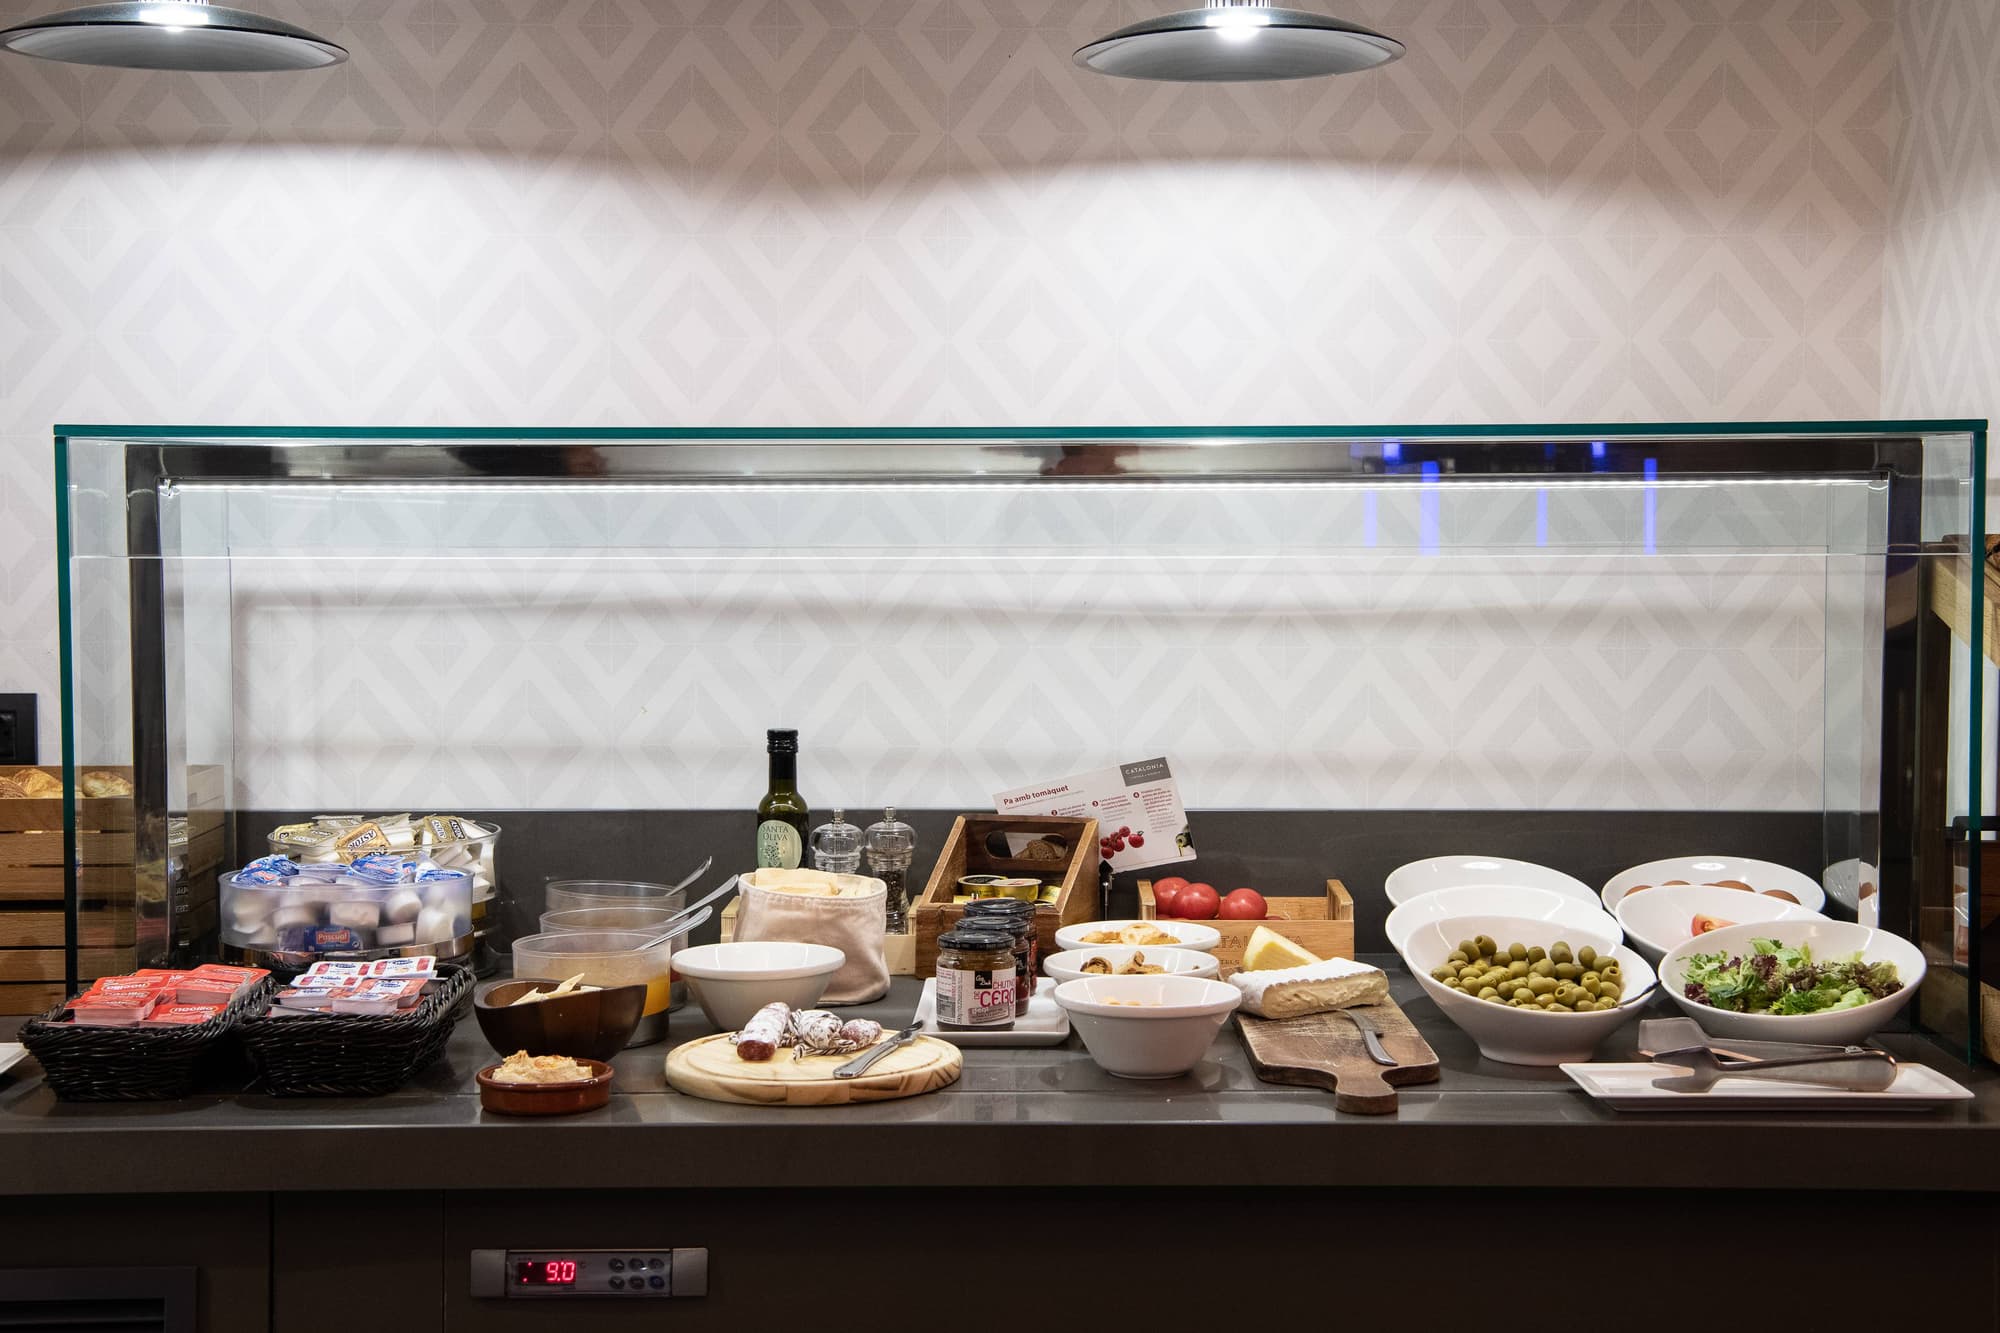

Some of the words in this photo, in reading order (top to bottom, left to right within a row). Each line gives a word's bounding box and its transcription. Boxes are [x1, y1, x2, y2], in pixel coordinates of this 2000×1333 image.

[1125, 763, 1164, 775] CATALONIA
[1014, 793, 1031, 803] amb
[1032, 784, 1070, 799] tomàquet
[761, 825, 789, 833] SANTA
[762, 833, 789, 841] OLIVA
[318, 933, 347, 943] Pascual
